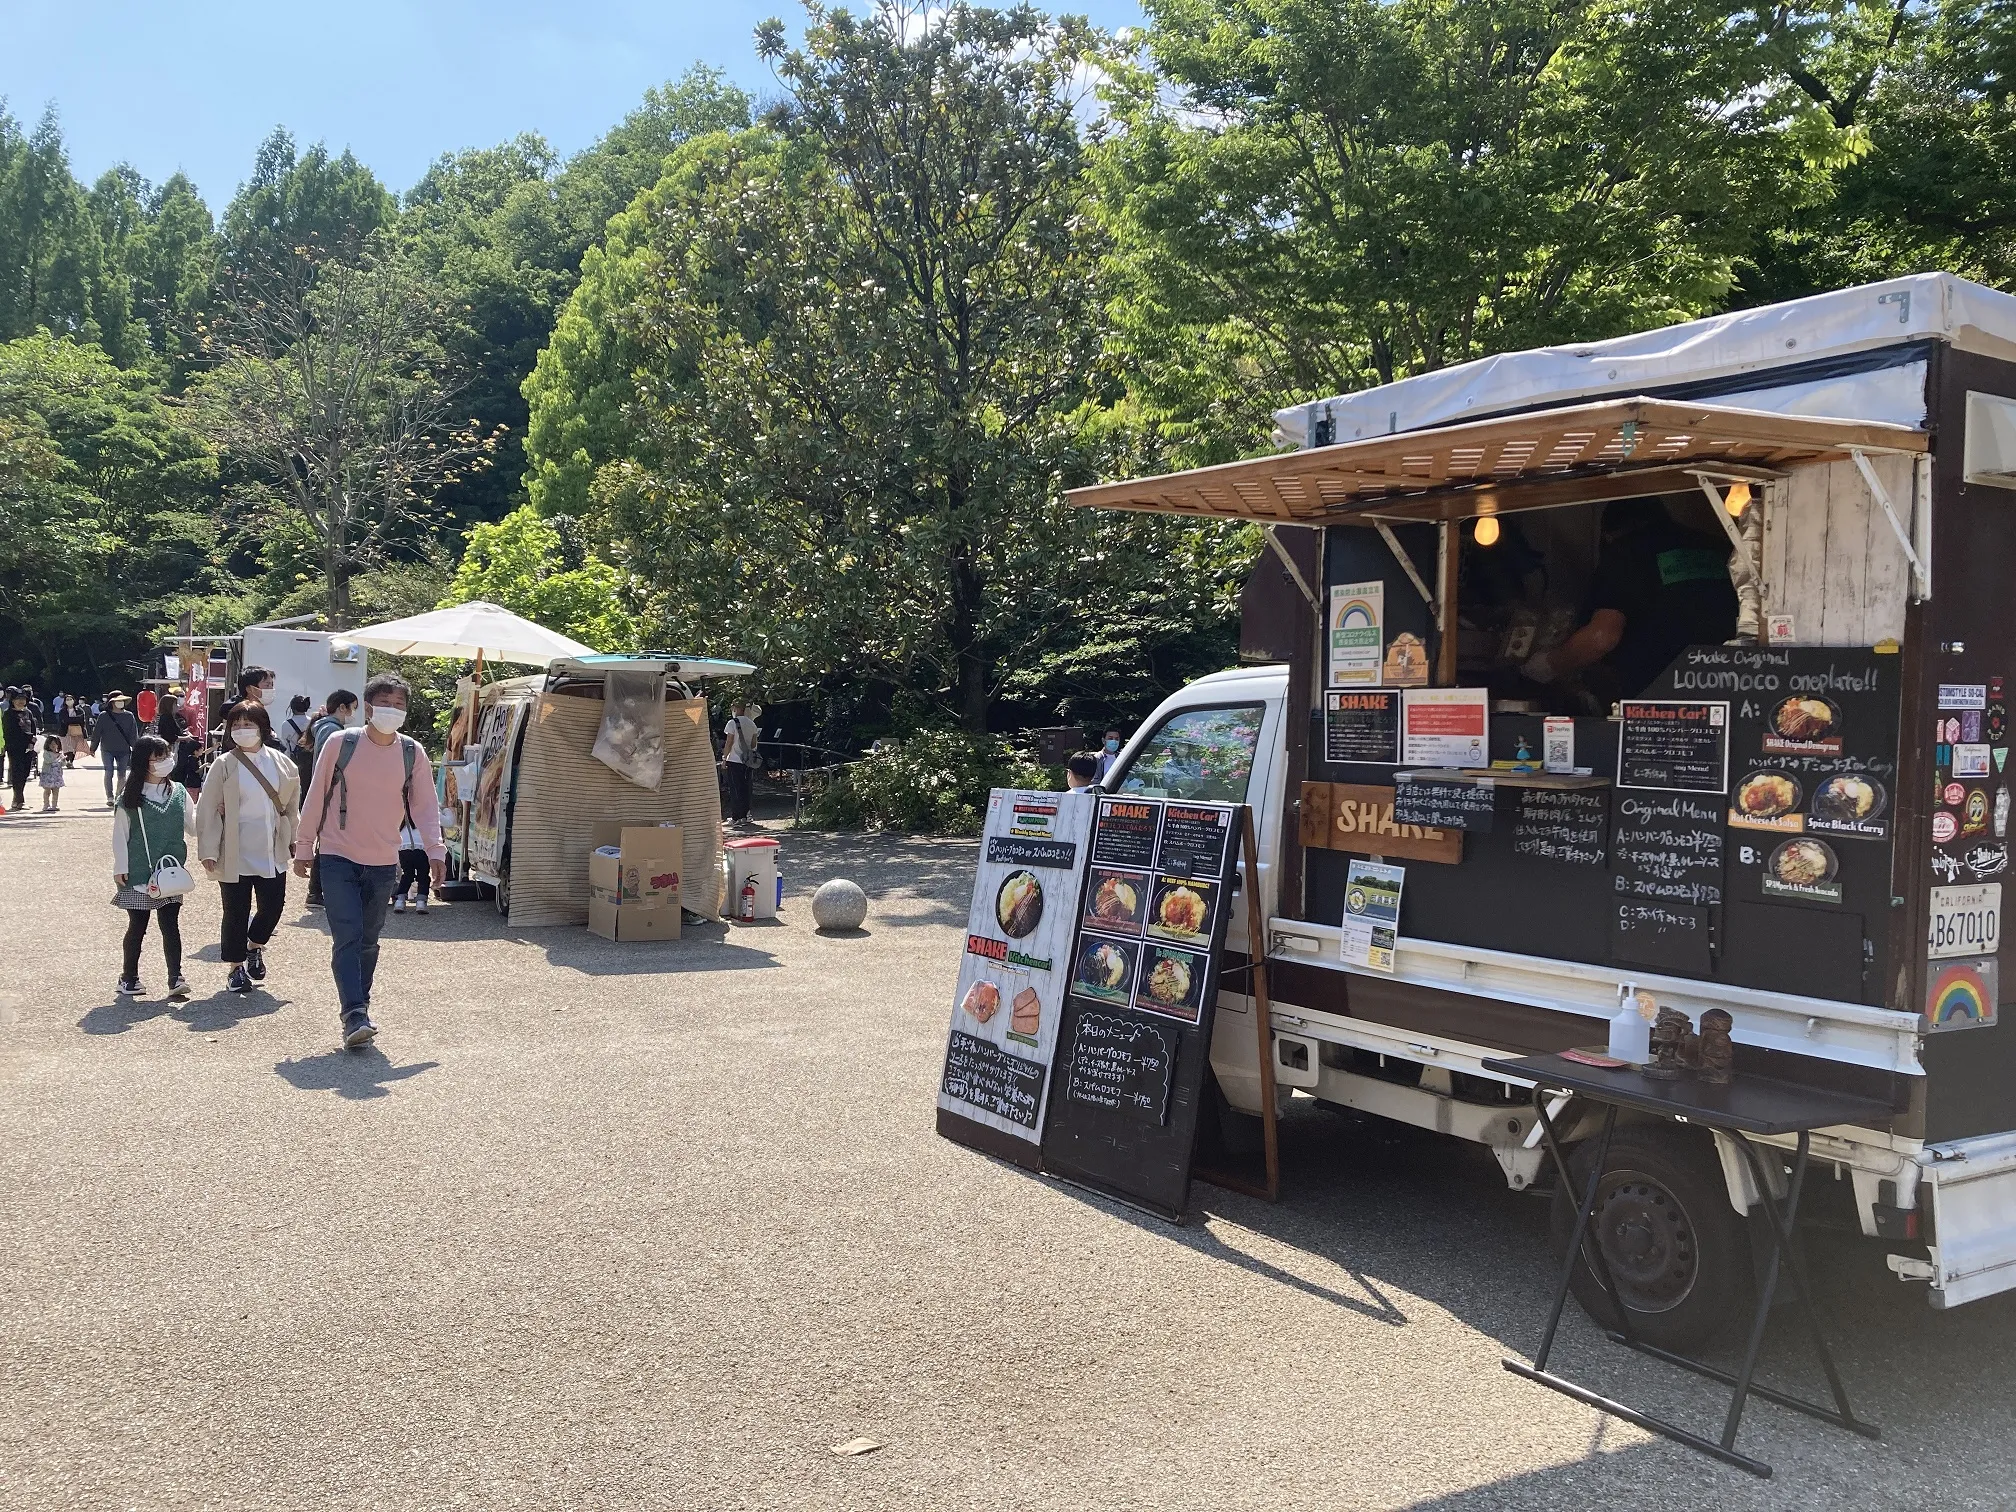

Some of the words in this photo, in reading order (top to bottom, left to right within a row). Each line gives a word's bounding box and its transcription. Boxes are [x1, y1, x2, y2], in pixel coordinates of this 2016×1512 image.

[1733, 650, 1790, 668] Original
[1340, 694, 1389, 709] SHAKE
[1740, 699, 1761, 718] A:
[1625, 705, 1676, 719] Kitchen
[1678, 706, 1708, 720] Car!
[1766, 738, 1785, 748] SHAKE
[1785, 739, 1808, 750] Original
[1111, 804, 1151, 819] SHAKE
[1167, 807, 1199, 819] Kitchen
[1200, 811, 1219, 821] Car!
[1621, 798, 1679, 825] Original
[1682, 800, 1717, 823] Menu
[1731, 814, 1744, 823] Hot
[1744, 815, 1771, 826] Cheese
[1771, 817, 1778, 827] &
[1778, 818, 1799, 828] Salsa
[1807, 818, 1831, 830] Spice
[1831, 819, 1856, 832] Black
[1857, 822, 1884, 836] Curry
[1740, 845, 1762, 864] B:
[1799, 883, 1814, 894] Fresh
[967, 936, 1007, 960] SHAKE
[1009, 951, 1052, 970] Kitchencar!
